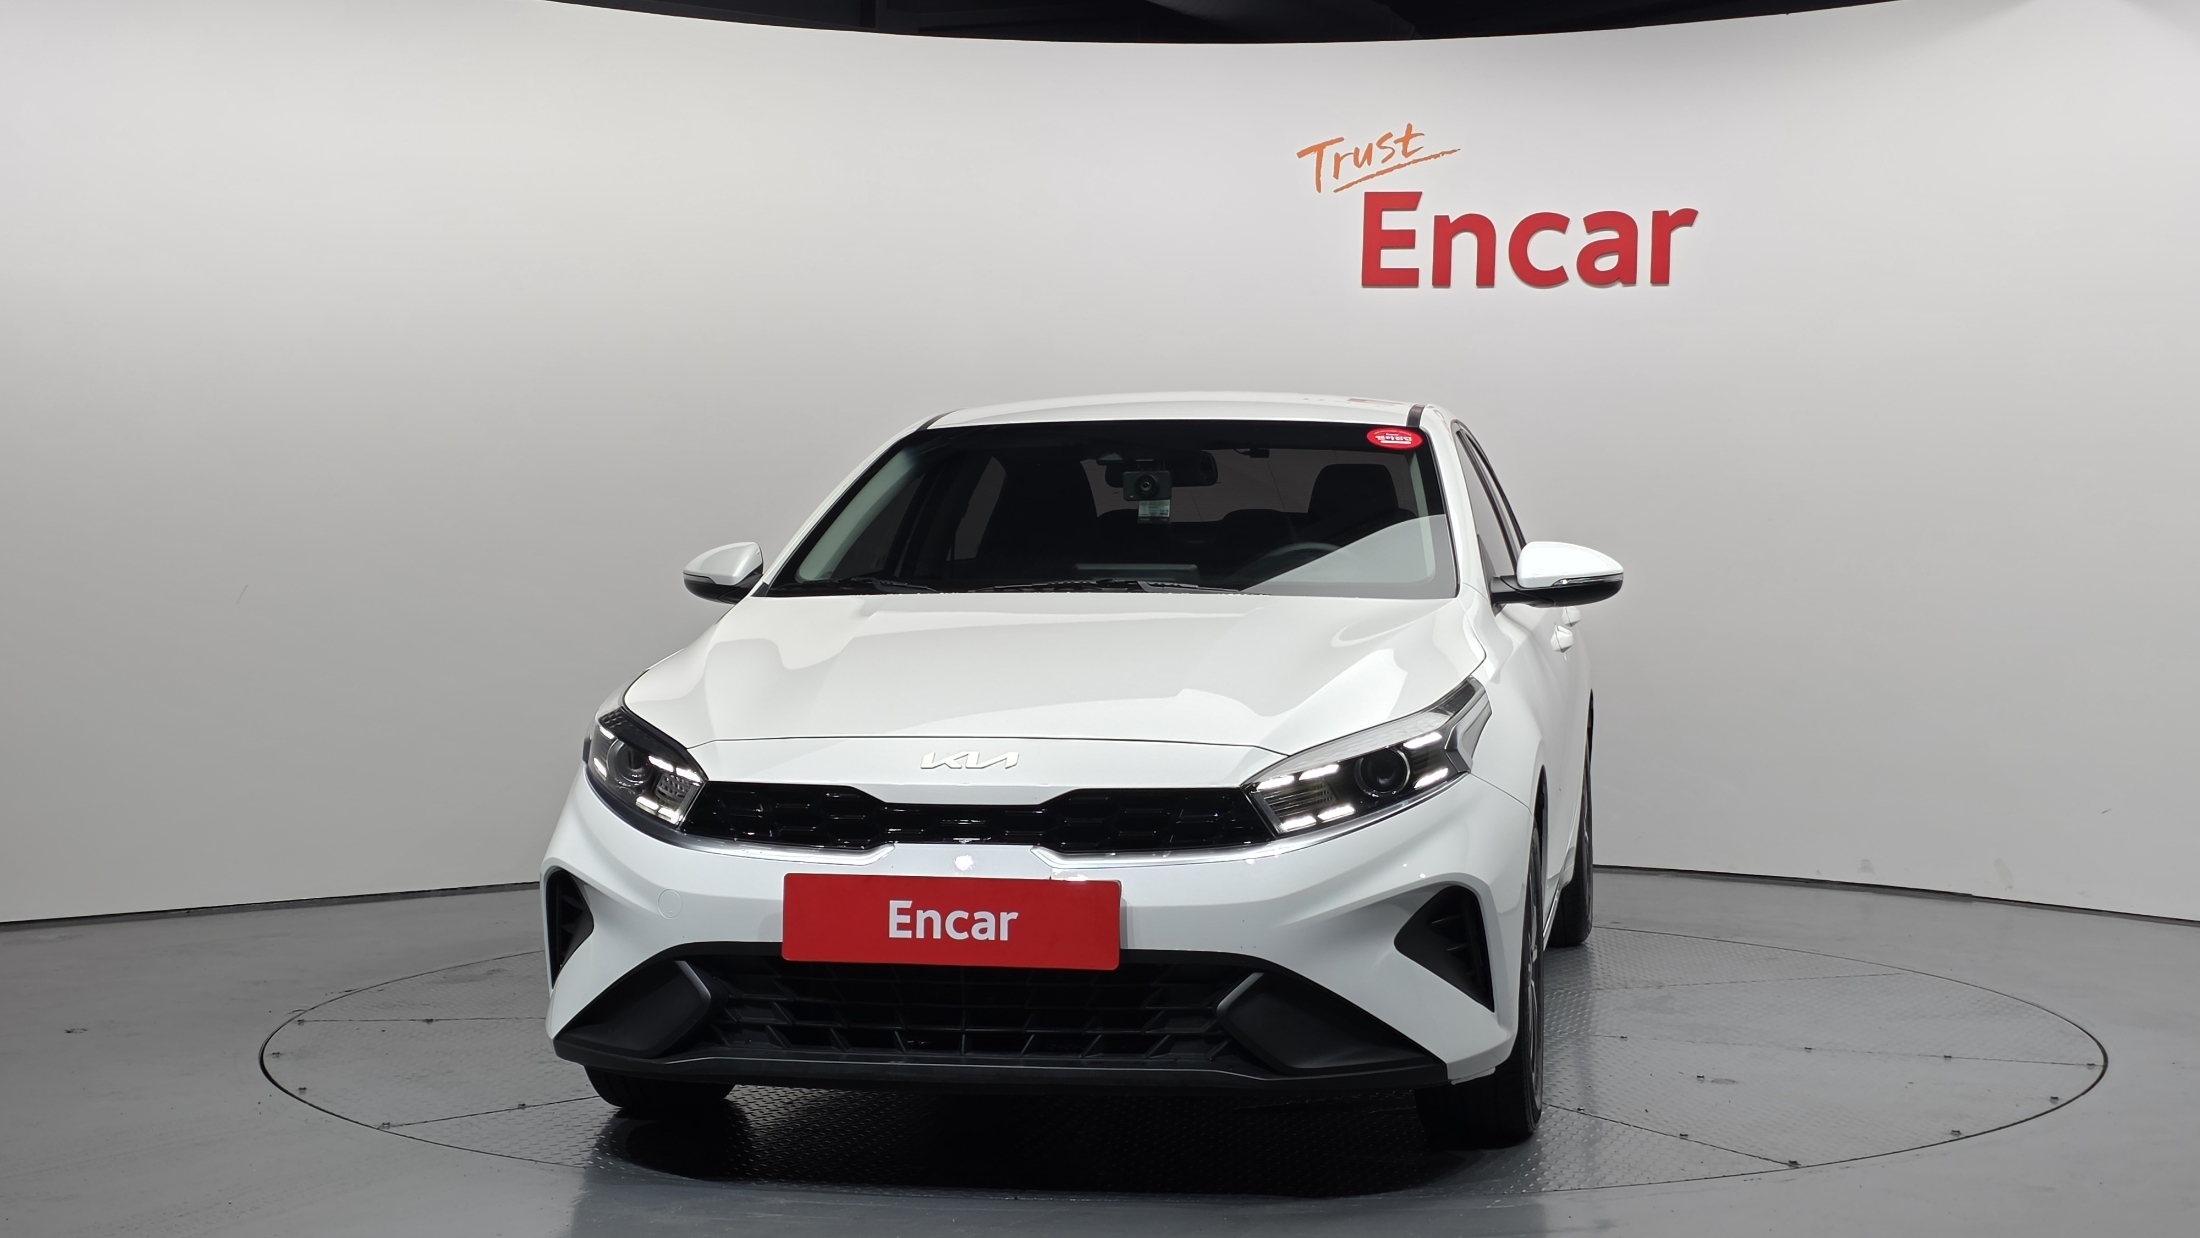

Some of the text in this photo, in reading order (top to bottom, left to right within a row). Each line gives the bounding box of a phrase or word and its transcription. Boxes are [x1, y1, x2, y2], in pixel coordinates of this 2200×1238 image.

[1297, 123, 1425, 193] Trust
[1362, 191, 1698, 288] Encar
[888, 899, 1019, 941] Encar
